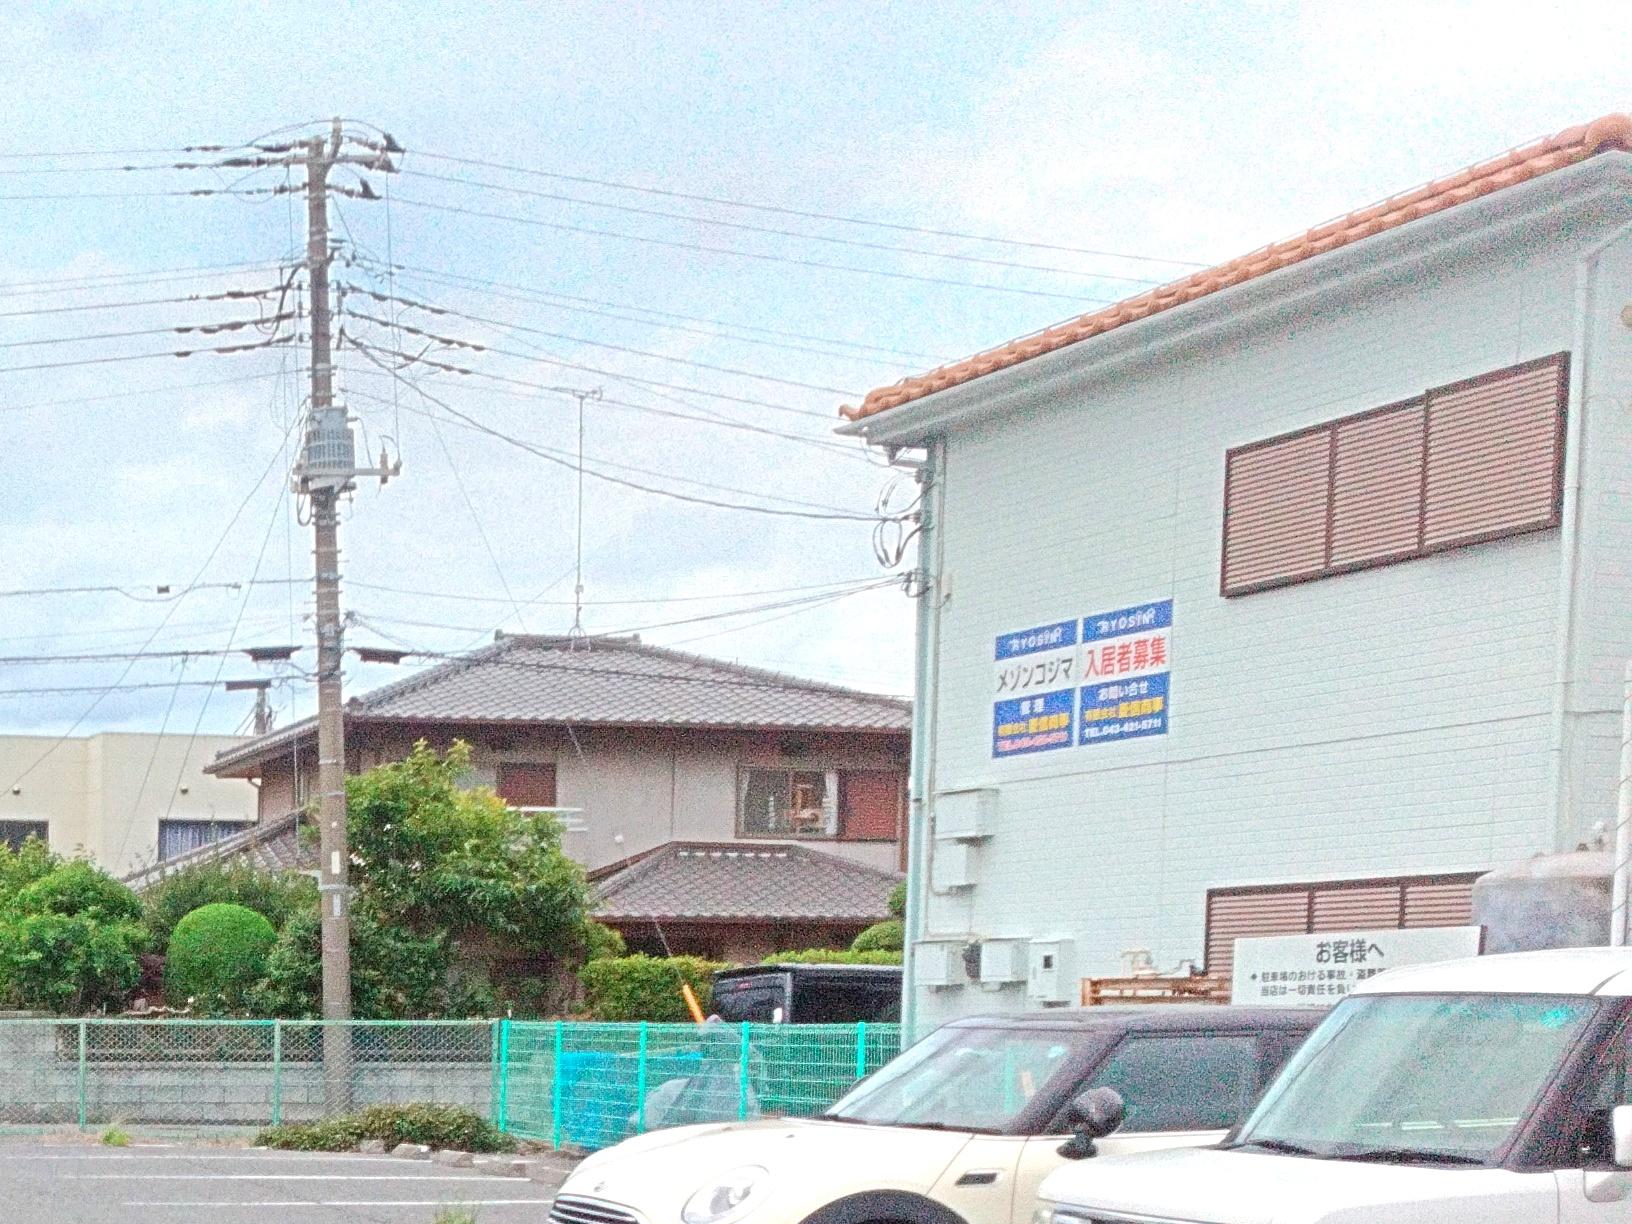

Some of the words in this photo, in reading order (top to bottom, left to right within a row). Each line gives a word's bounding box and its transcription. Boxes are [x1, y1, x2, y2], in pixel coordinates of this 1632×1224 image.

[1084, 635, 1167, 679] 入居者募集
[997, 658, 1073, 692] メゾンコジマ
[1315, 939, 1384, 963] お客様へ
